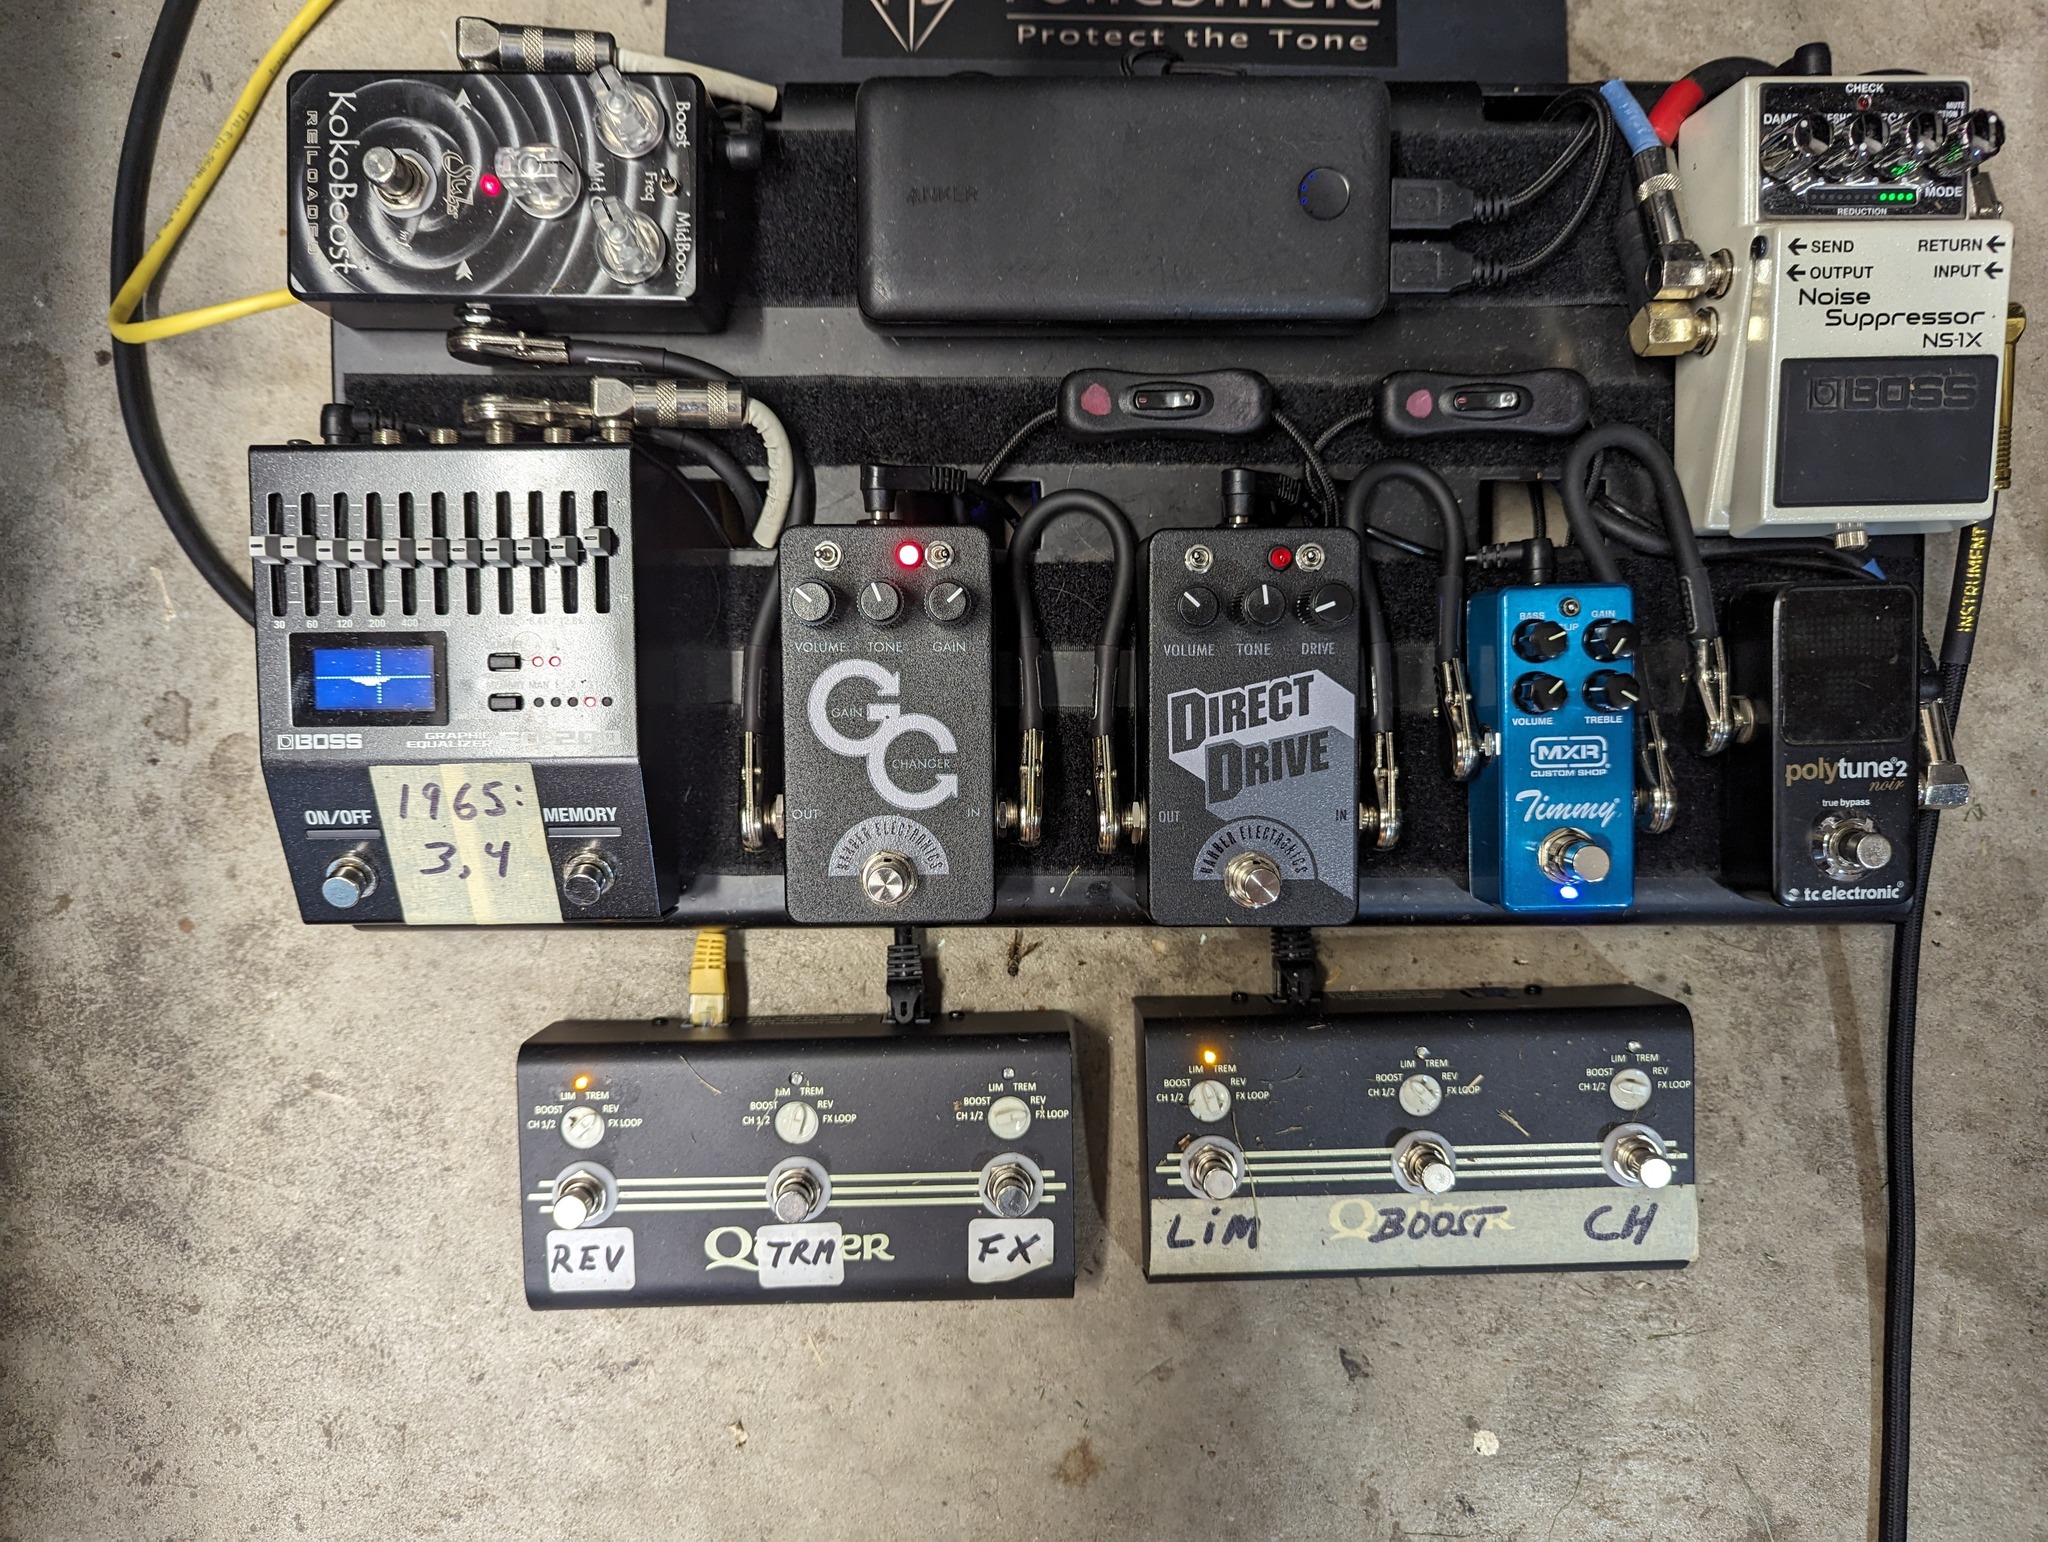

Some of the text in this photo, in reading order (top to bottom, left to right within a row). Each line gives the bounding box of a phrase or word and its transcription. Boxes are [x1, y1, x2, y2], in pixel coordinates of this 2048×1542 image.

[1016, 24, 1369, 52] Protect the Tone
[1845, 83, 1884, 94] CHECK
[676, 101, 690, 148] Boost
[639, 171, 658, 202] Freq
[1925, 186, 1963, 198] MODE
[906, 186, 978, 203] ANKER
[1837, 207, 1888, 216] REDUCTION
[675, 211, 692, 287] MidBoost
[1811, 240, 1855, 254] SEND
[1918, 238, 1983, 252] RETURN
[1810, 266, 1874, 280] OUTPUT
[1934, 265, 1981, 278] INPUT
[1799, 287, 1872, 306] Noise
[1825, 309, 1986, 331] Suppressor
[1923, 332, 1983, 349] NS-1X
[1844, 376, 1978, 410] BOSS
[1957, 526, 1988, 633] INSTRUMENT
[1519, 609, 1616, 620] BASS GAIN
[273, 620, 286, 629] 30
[306, 620, 318, 629] 60
[337, 620, 353, 628] 120
[369, 620, 386, 628] 200
[401, 619, 419, 628] 400
[795, 641, 966, 653] VOLUME TONE GAIN
[1163, 643, 1336, 656] VOLUME TONE DRIVE
[831, 707, 863, 718] GAIN
[1171, 674, 1316, 754] DIRECT
[1512, 715, 1624, 726] VOLUME TREBLE
[295, 734, 363, 750] BOSS
[406, 740, 492, 749] EQUALIZER
[1538, 743, 1600, 760] MXR
[892, 759, 951, 770] CHANGER
[1206, 730, 1330, 803] DRIVE
[1530, 767, 1607, 777] CUSTOM SHOP
[1868, 779, 1904, 792] noir
[1515, 789, 1616, 827] Timmy
[1822, 799, 1870, 810] true bypass
[306, 809, 371, 825] ON/OFF
[544, 807, 617, 822] MEMORY
[792, 809, 820, 820] OUT
[967, 808, 980, 817] IN
[1158, 810, 1180, 823] OUT
[1335, 809, 1348, 820] IN
[1201, 824, 1309, 874] BARBER ELECTRONICS
[1804, 886, 1899, 900] tc electronic
[1400, 1060, 1415, 1068] LIM
[1611, 1054, 1659, 1063] LIM TREM
[1189, 1065, 1203, 1073] LIM
[1652, 1067, 1668, 1075] REV
[1375, 1074, 1402, 1082] BOOST
[1442, 1072, 1458, 1080] REV
[988, 1083, 1003, 1091] LIM
[1163, 1079, 1191, 1087] BOOST
[1579, 1083, 1606, 1092] CH 1/2
[1657, 1081, 1691, 1089] FX LOOP
[560, 1092, 576, 1100] LIM
[776, 1087, 823, 1096] LIM TREM
[1368, 1088, 1395, 1097] CH 1/2
[964, 1097, 991, 1105] BOOST
[1156, 1093, 1184, 1102] CH 1/2
[535, 1106, 563, 1114] BOOST
[750, 1102, 777, 1110] BOOST
[823, 1114, 856, 1122] FX LOOP
[956, 1112, 983, 1120] CH 1/2
[1036, 1110, 1069, 1118] FX LOOP
[528, 1120, 556, 1129] CH 1/2
[608, 1118, 642, 1126] FX LOOP
[742, 1116, 770, 1124] CH 1/2
[1368, 1205, 1508, 1243] BOOST
[1584, 1203, 1660, 1245] CH
[767, 1239, 836, 1268] TRM
[978, 1235, 1042, 1264] FX
[551, 1244, 625, 1273] REV
